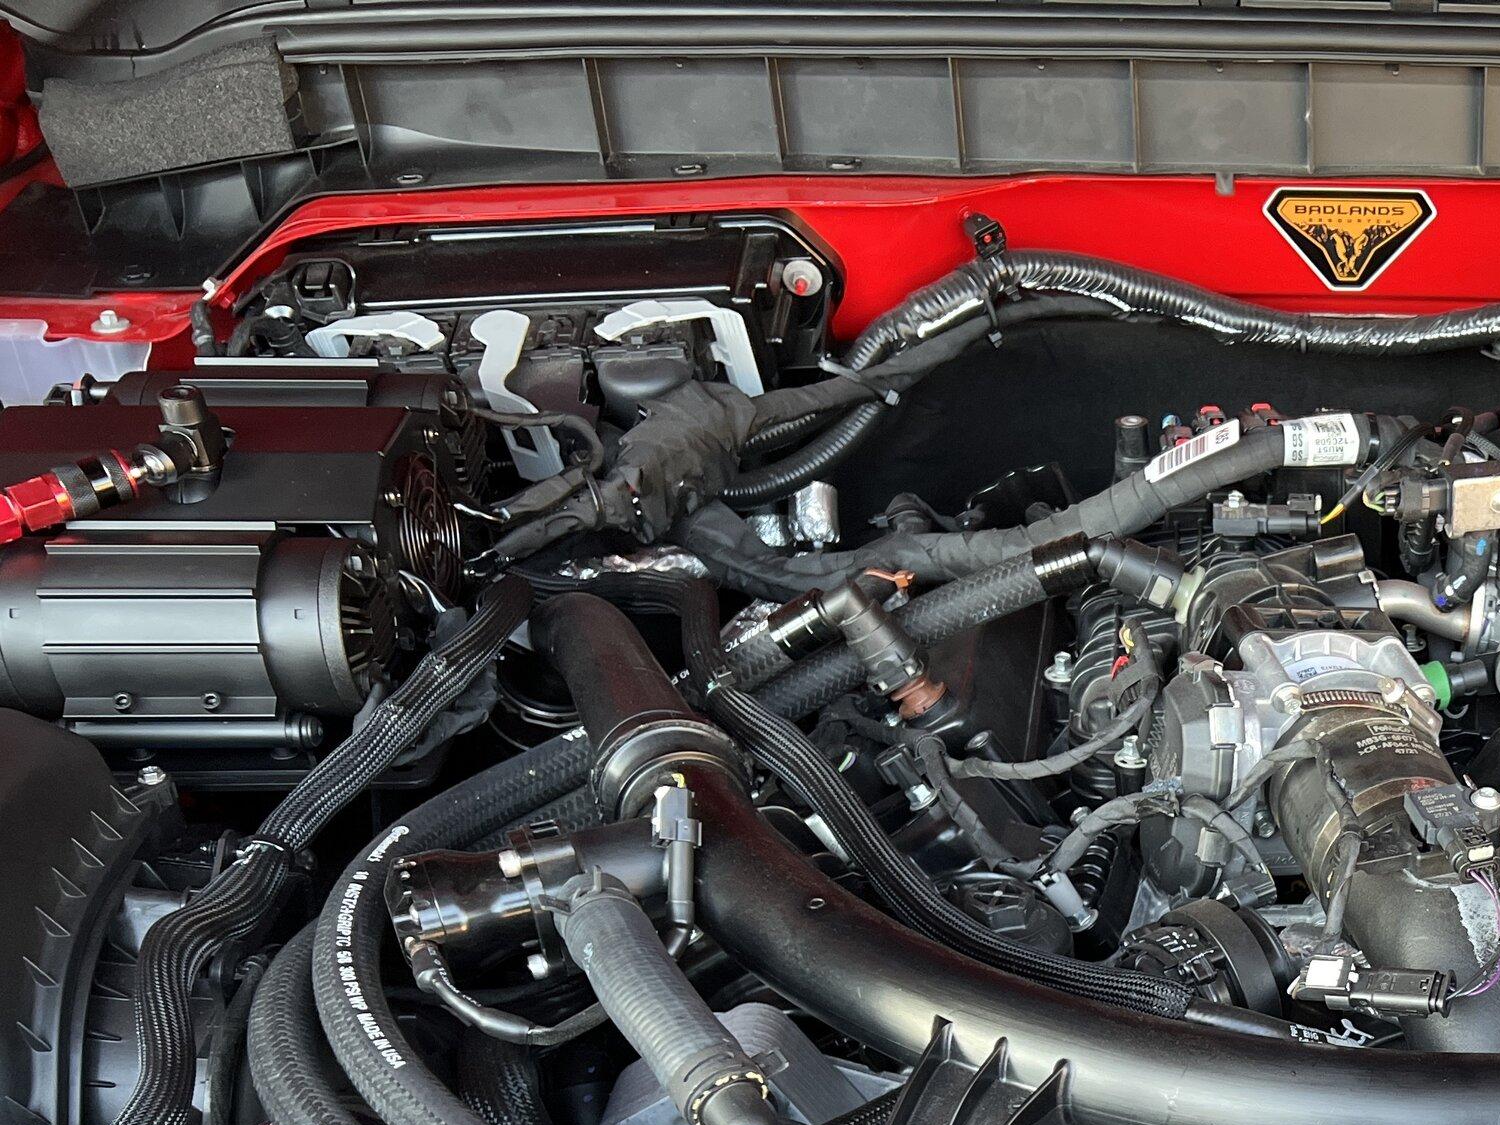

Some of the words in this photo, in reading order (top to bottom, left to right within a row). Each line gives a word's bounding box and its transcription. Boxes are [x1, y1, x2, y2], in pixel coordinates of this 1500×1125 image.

[1294, 204, 1405, 216] BADLANDS
[338, 965, 357, 981] 300
[343, 981, 362, 997] PSI
[348, 996, 369, 1011] WP
[356, 1012, 386, 1040] MADE
[372, 1038, 392, 1051] IN
[381, 1048, 407, 1069] USA
